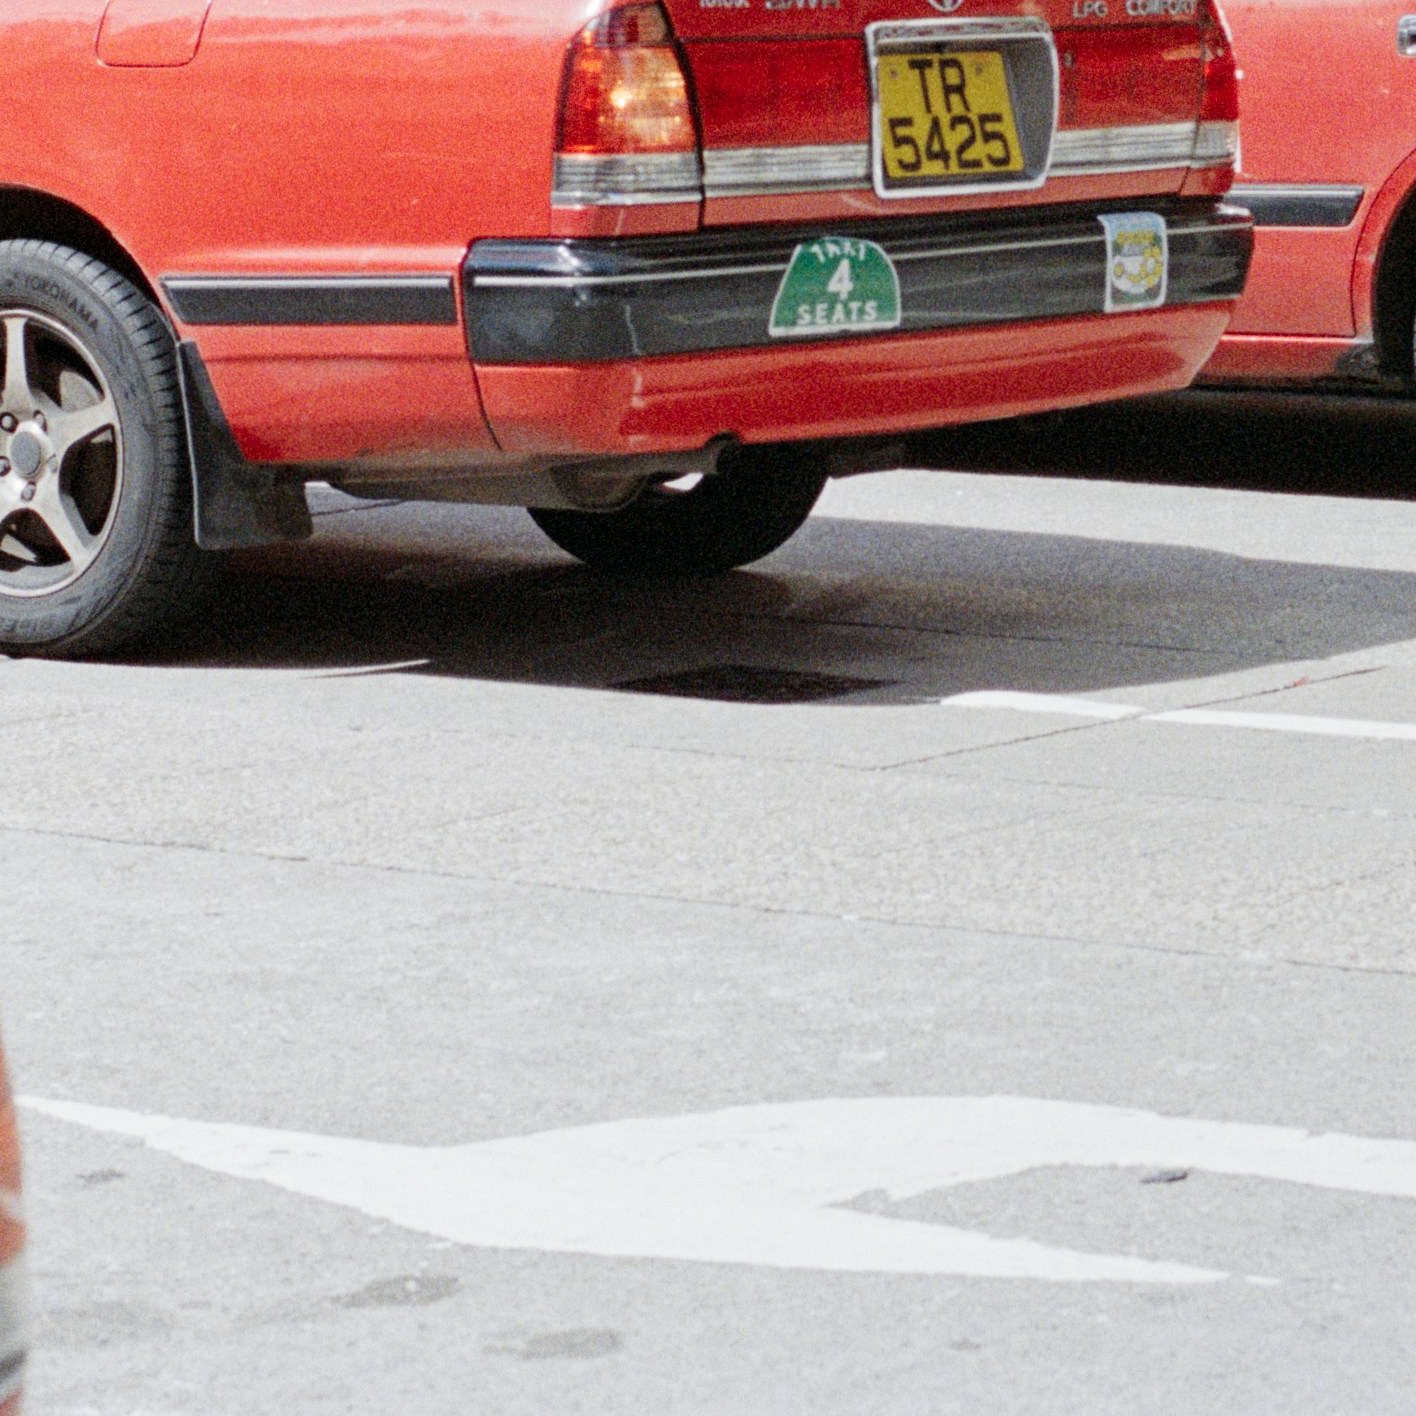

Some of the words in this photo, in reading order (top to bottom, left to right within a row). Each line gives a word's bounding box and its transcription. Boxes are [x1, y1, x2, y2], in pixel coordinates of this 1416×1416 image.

[1072, 0, 1109, 19] LPG
[907, 59, 972, 114] TR
[888, 113, 1012, 173] 5425
[827, 259, 854, 296] 4
[796, 298, 880, 325] SEATS
